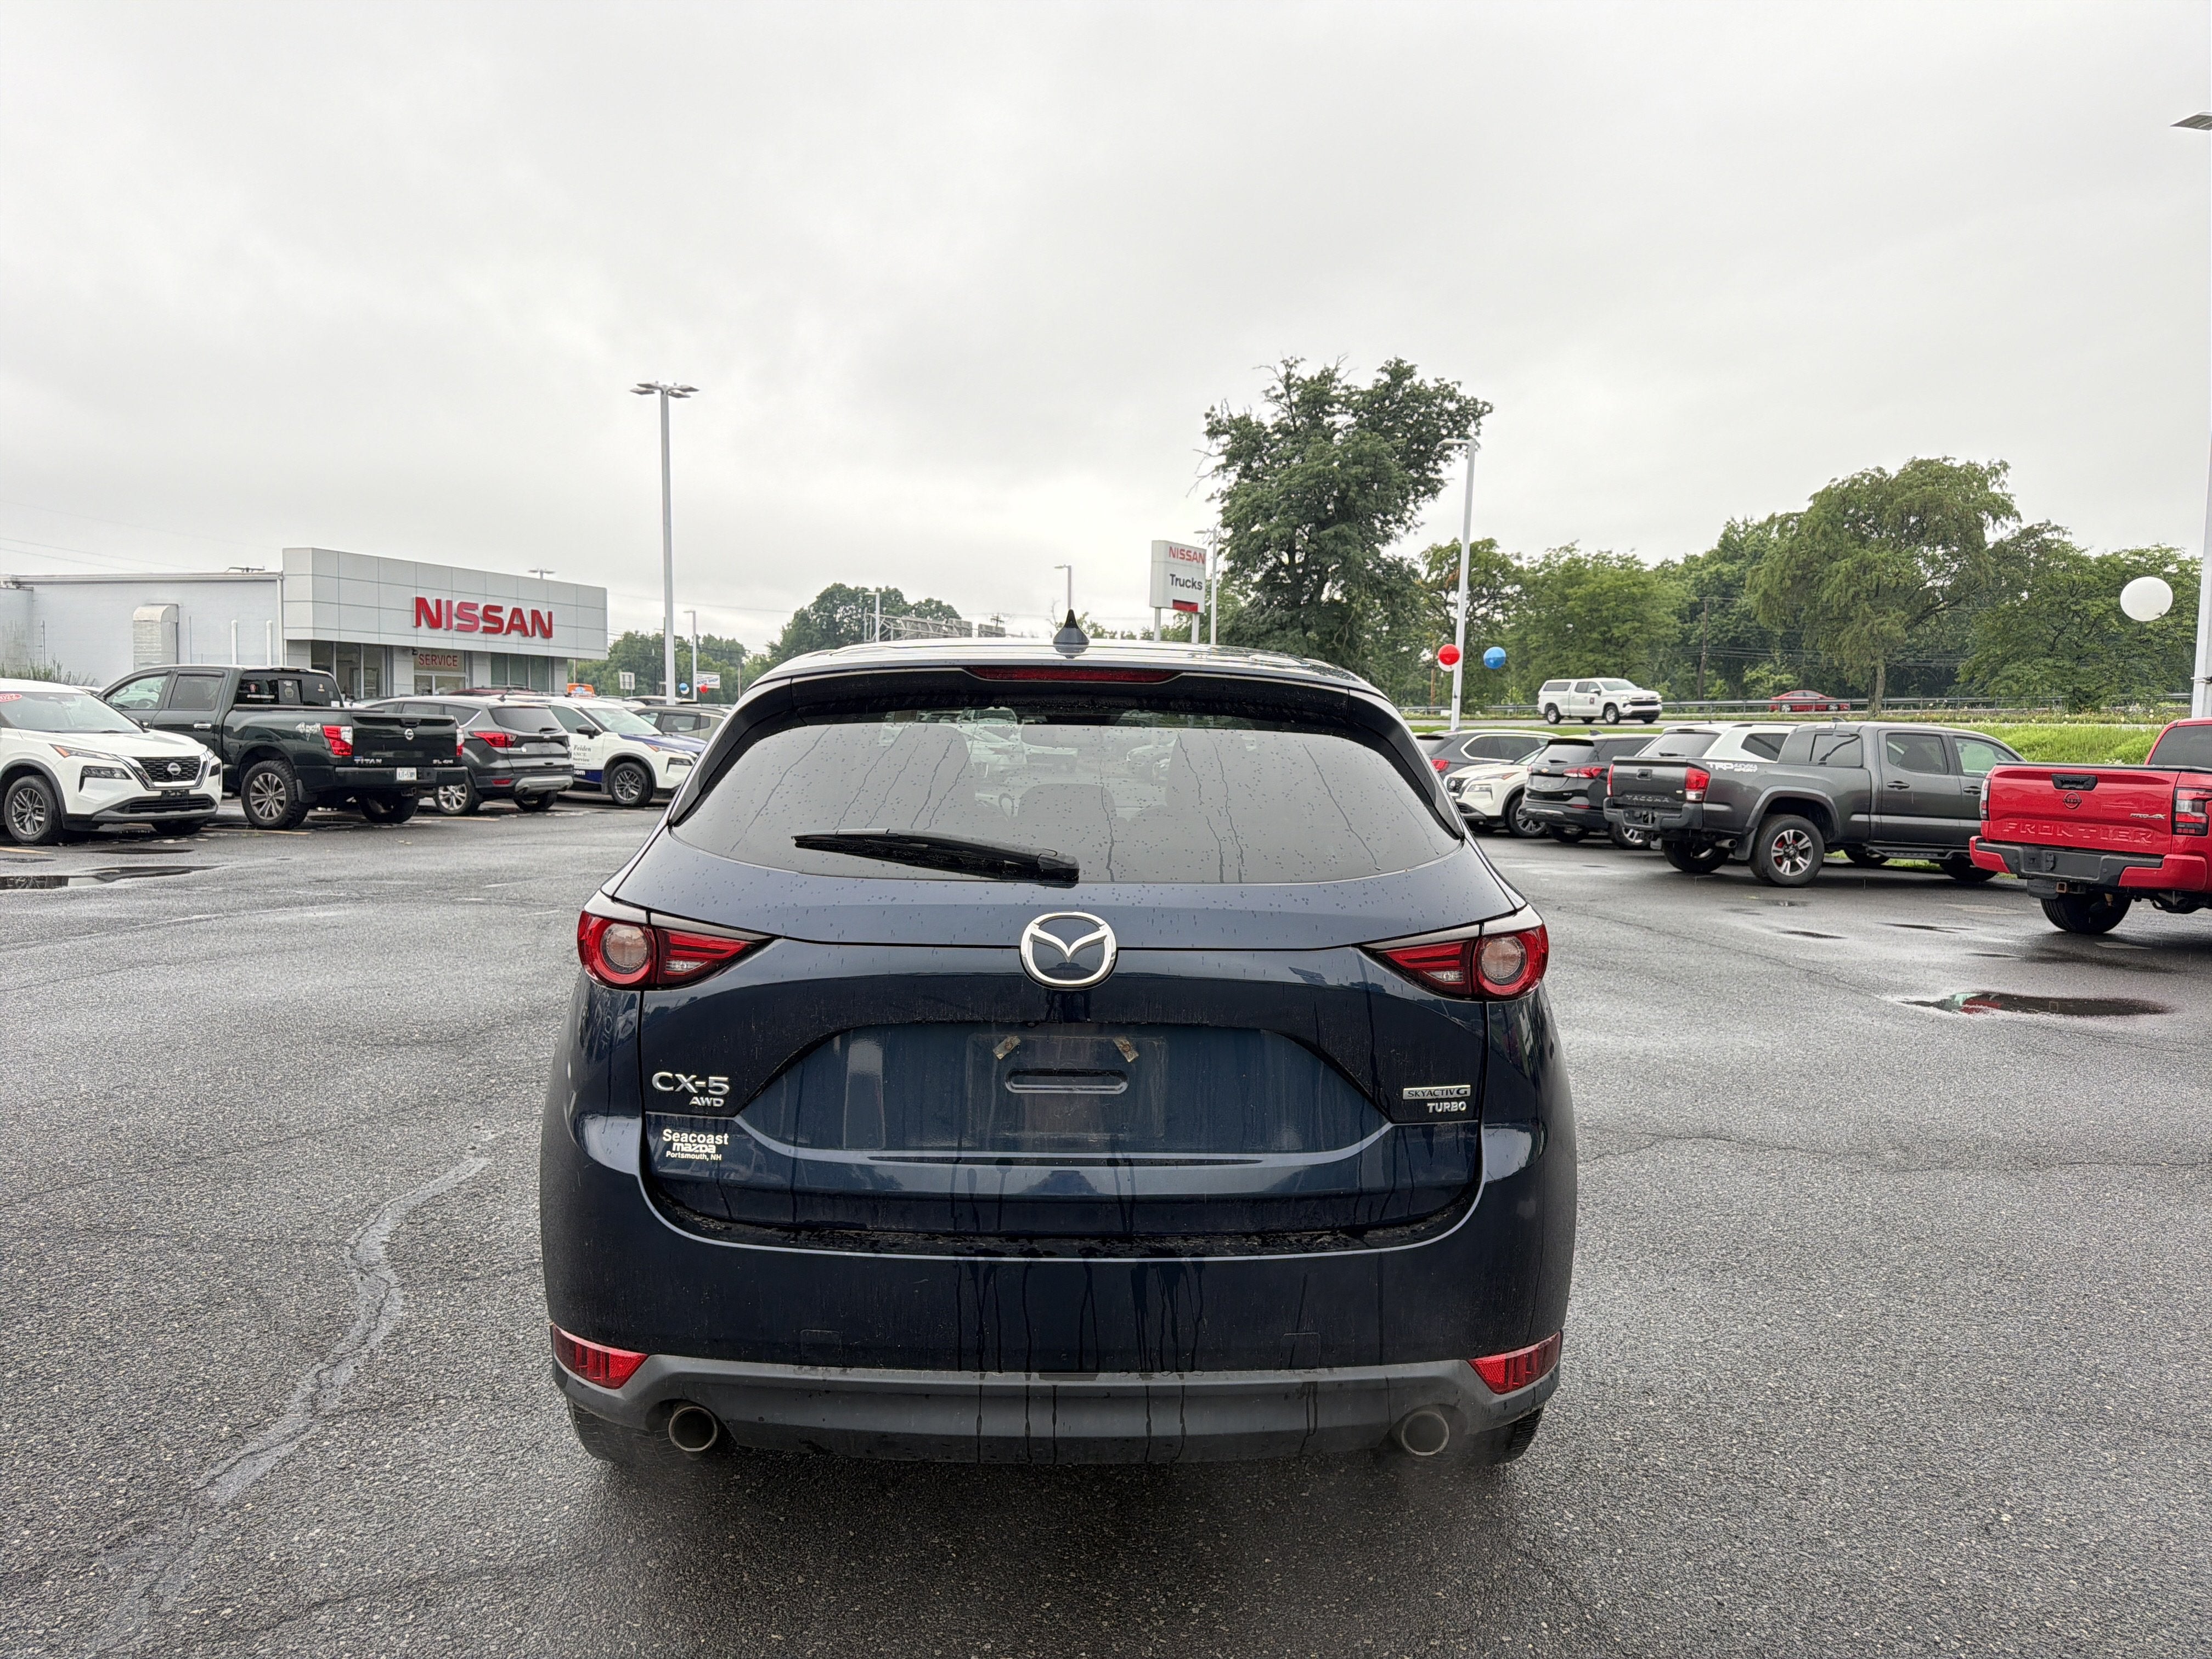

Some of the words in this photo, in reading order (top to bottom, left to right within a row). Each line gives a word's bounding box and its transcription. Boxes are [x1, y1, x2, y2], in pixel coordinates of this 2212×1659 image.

[1169, 546, 1205, 564] NISSAN
[1170, 574, 1203, 590] Trucks
[414, 596, 553, 638] NISSAN
[419, 653, 458, 667] SERVICE
[1706, 761, 1734, 771] TRD
[1626, 794, 1670, 803] TACOMA
[2002, 822, 2152, 844] FRONTIER
[652, 1071, 730, 1096] CX-5
[689, 1096, 724, 1107] AWD
[1427, 1101, 1467, 1113] TURBO
[662, 1128, 729, 1145] Seacoast
[665, 1150, 709, 1161] Portsmouth,
